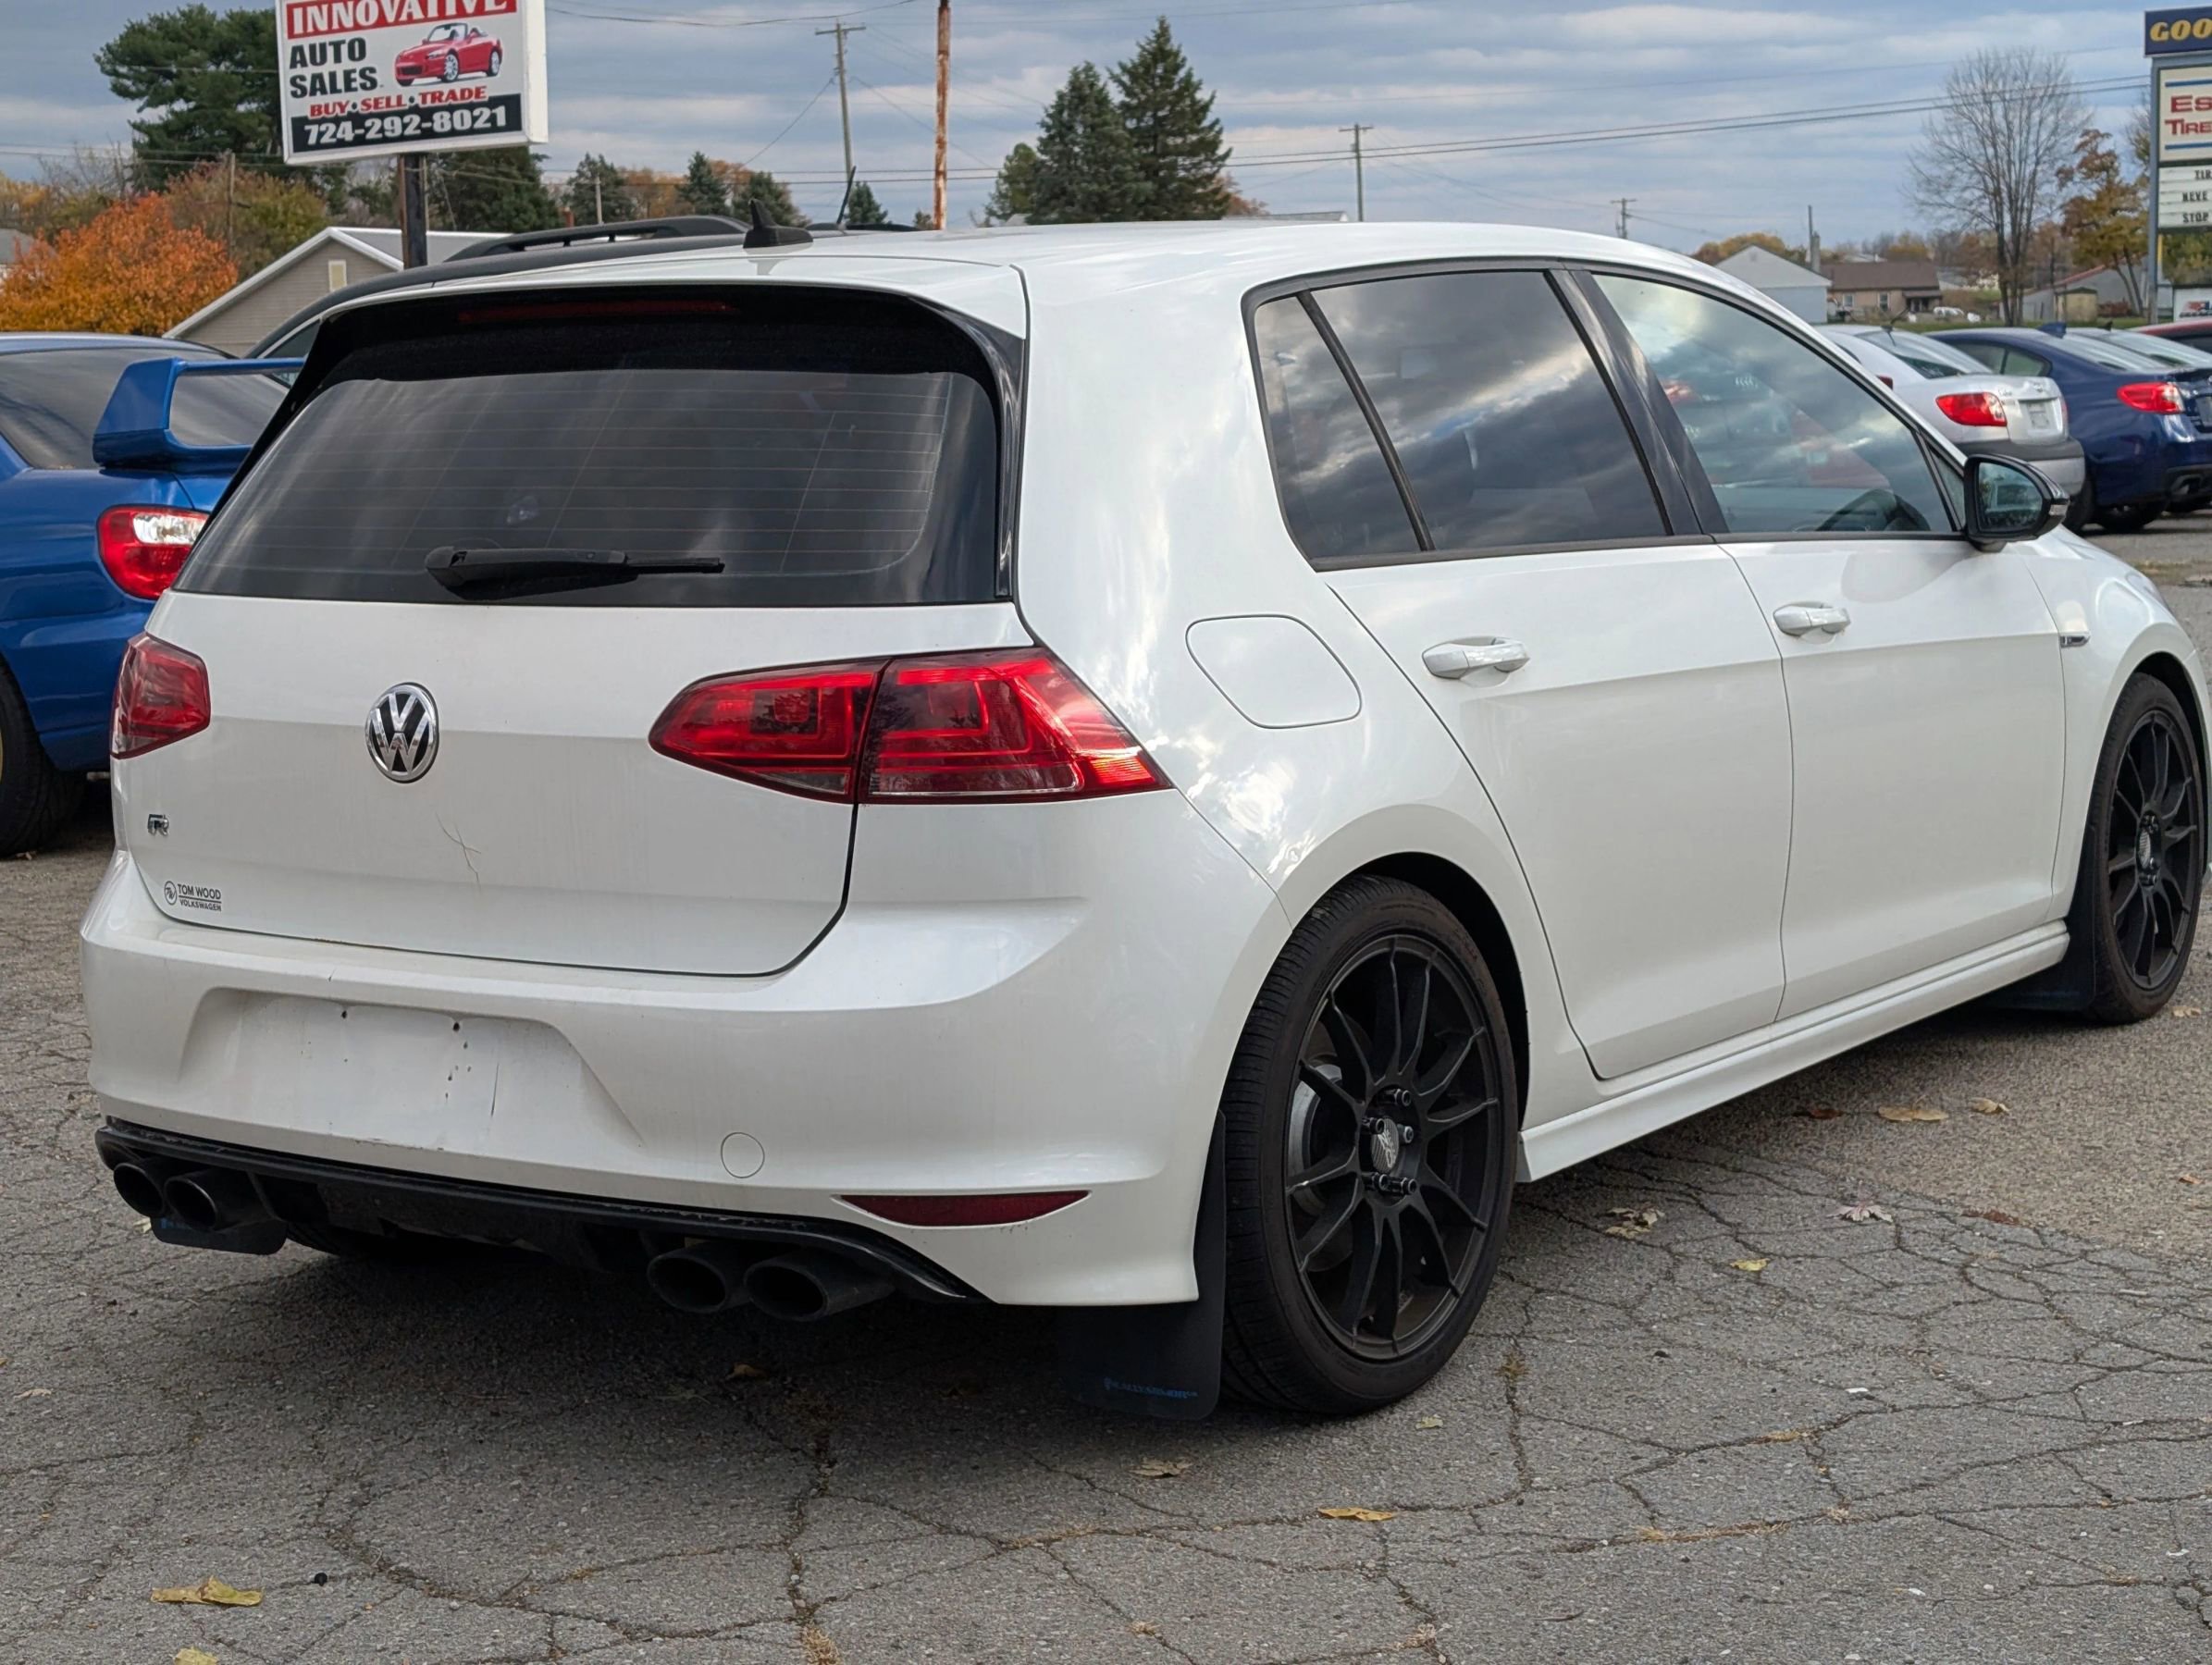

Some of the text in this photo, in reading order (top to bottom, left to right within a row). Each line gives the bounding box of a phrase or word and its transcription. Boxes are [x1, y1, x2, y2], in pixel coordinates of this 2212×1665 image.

[289, 37, 367, 69] AUTO
[289, 67, 378, 99] SALES
[310, 86, 487, 117] BUY SELL TRADE
[304, 106, 506, 145] 724-292-8021
[2182, 212, 2209, 223] STOP
[177, 883, 222, 900] TOM WOOD
[179, 899, 222, 911] VOLKSWAGEN
